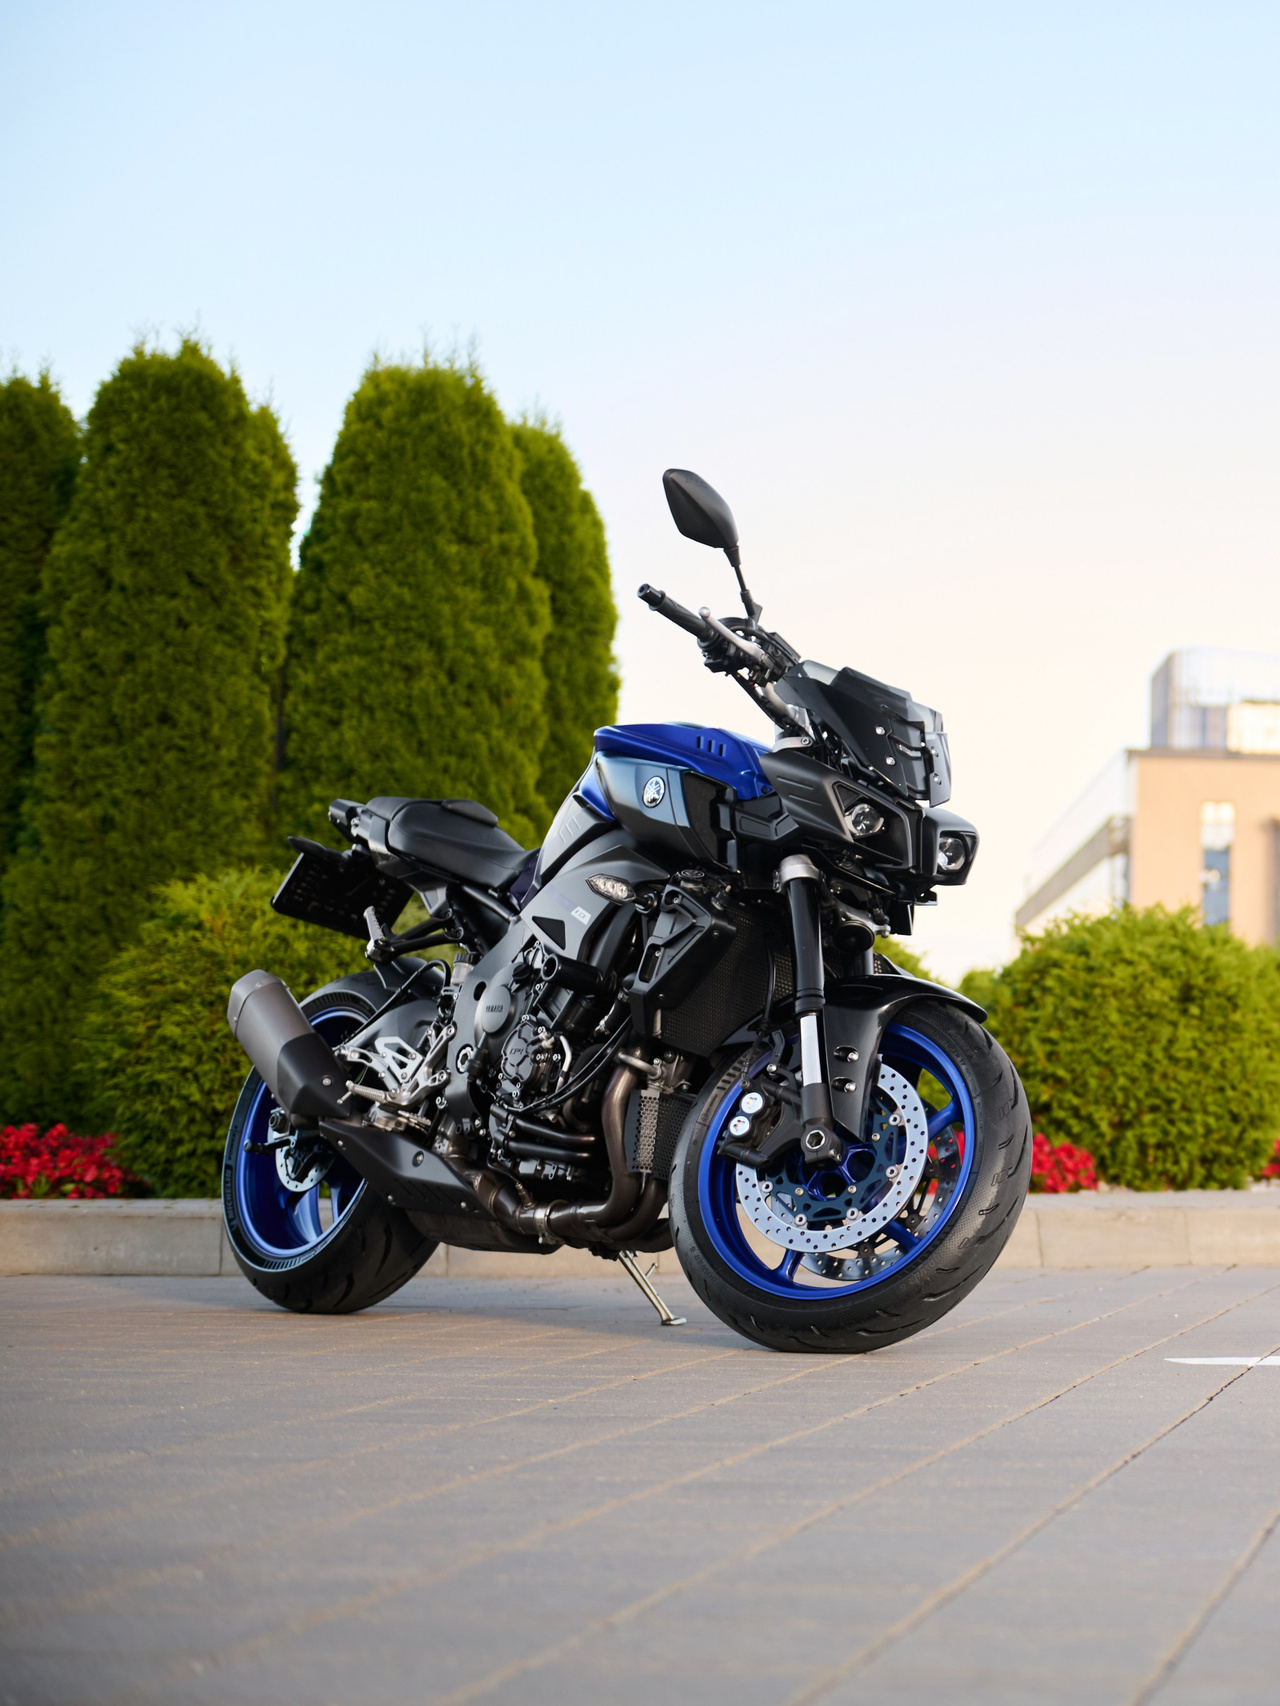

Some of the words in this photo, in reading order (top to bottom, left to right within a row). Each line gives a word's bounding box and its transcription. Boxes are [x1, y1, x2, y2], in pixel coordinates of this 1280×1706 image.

[485, 1004, 504, 1013] YAMAHA
[225, 1169, 234, 1219] MICHELIN
[694, 1254, 718, 1284] POWER
